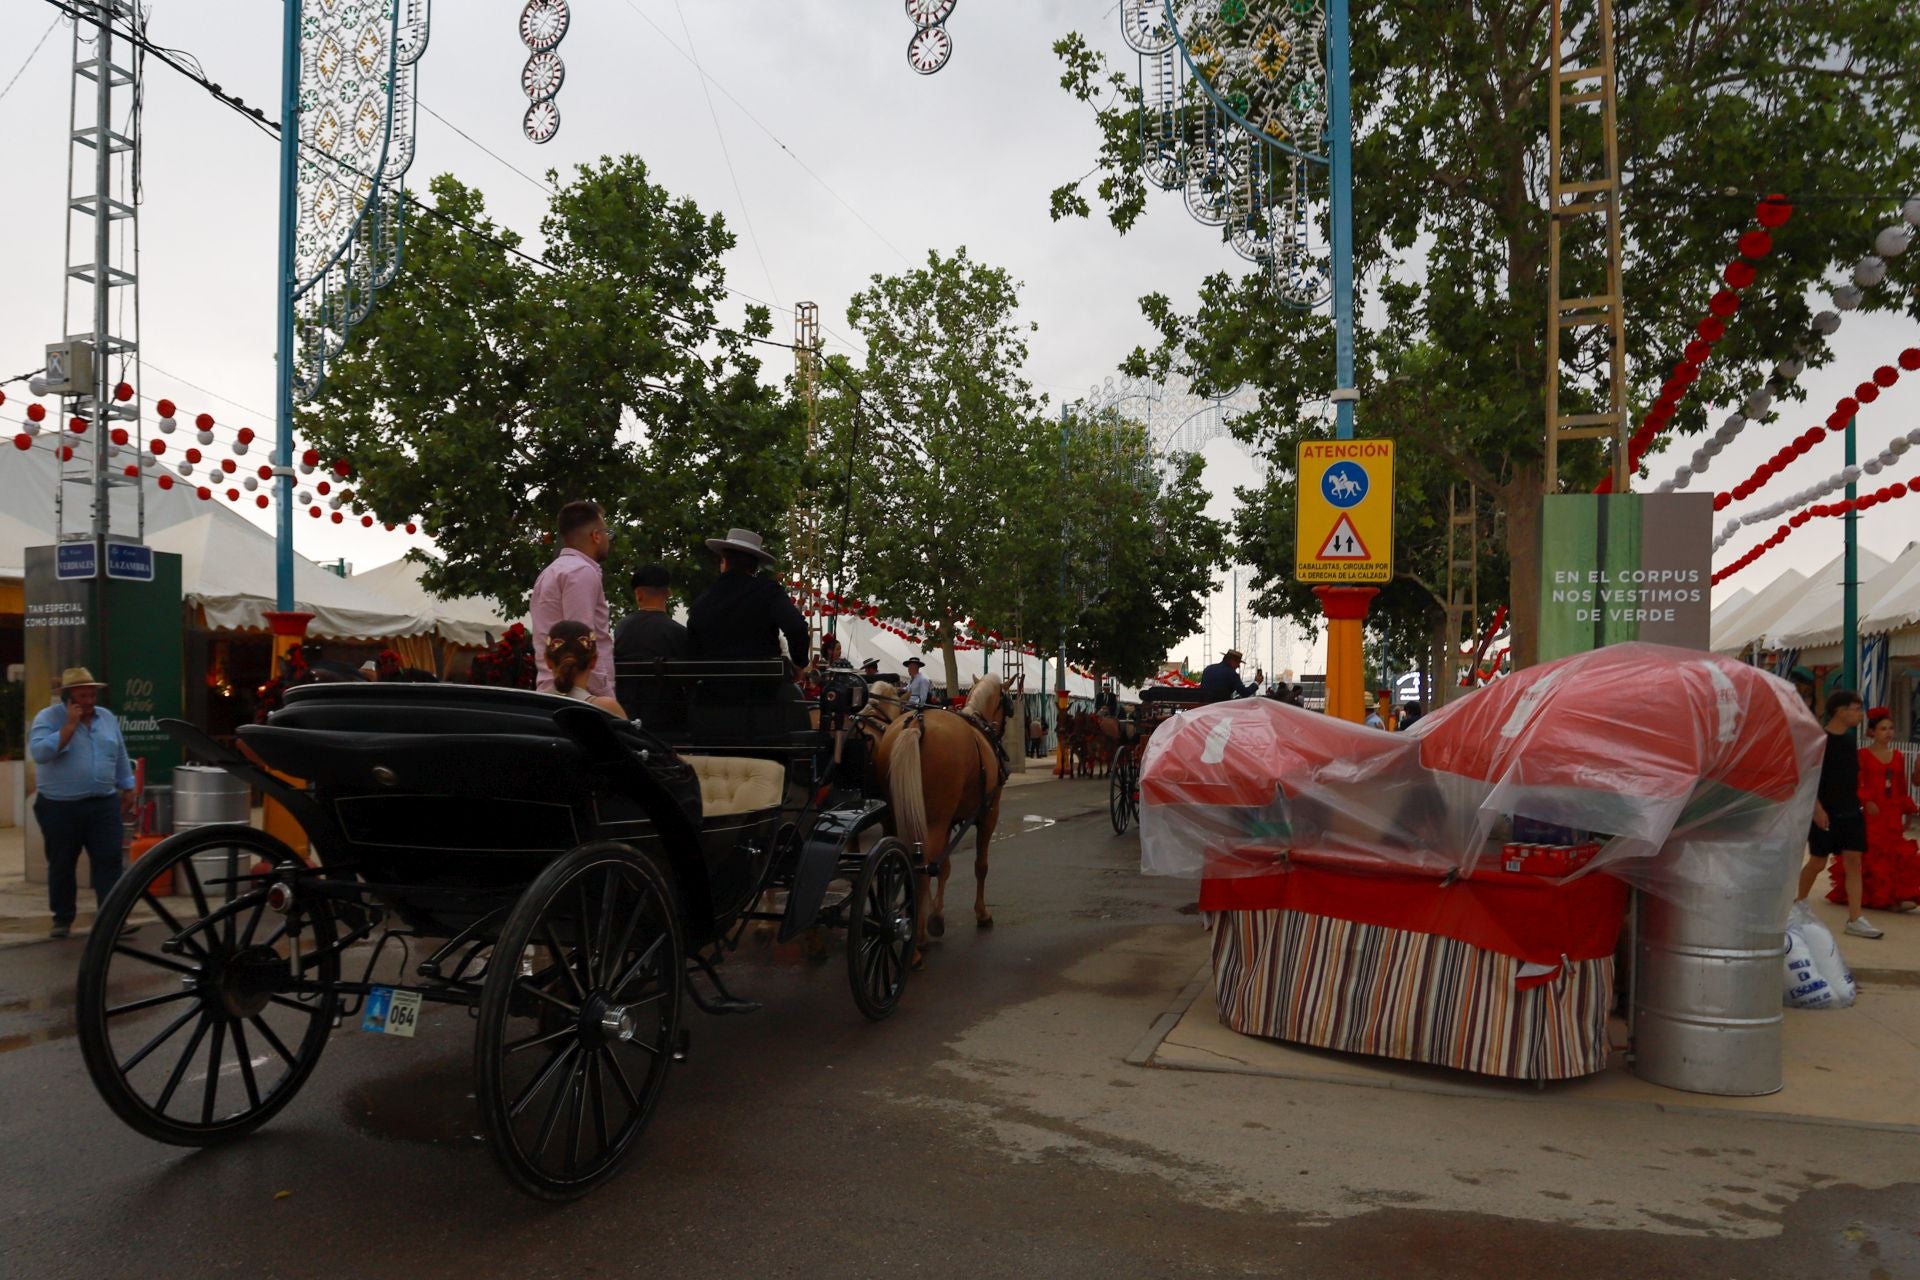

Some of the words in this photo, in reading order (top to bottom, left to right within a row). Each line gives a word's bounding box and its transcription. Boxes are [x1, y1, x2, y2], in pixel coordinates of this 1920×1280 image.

[1303, 443, 1389, 458] ATENCIÓN
[120, 561, 150, 572] ZAMBRA
[1298, 563, 1341, 571] CABALLISTAS,
[1554, 570, 1580, 584] EN
[1588, 570, 1611, 584] EL
[1618, 569, 1700, 584] CORPUS
[1552, 589, 1592, 603] NOS
[1600, 588, 1701, 603] VESTIMOS
[28, 604, 44, 614] TAN
[44, 602, 83, 613] ESPECIAL
[1576, 608, 1601, 622] DE
[1609, 608, 1676, 622] VERDE
[25, 617, 48, 628] COMO
[48, 616, 87, 627] GRANADA
[125, 678, 154, 697] 100
[390, 1005, 414, 1026] 064
